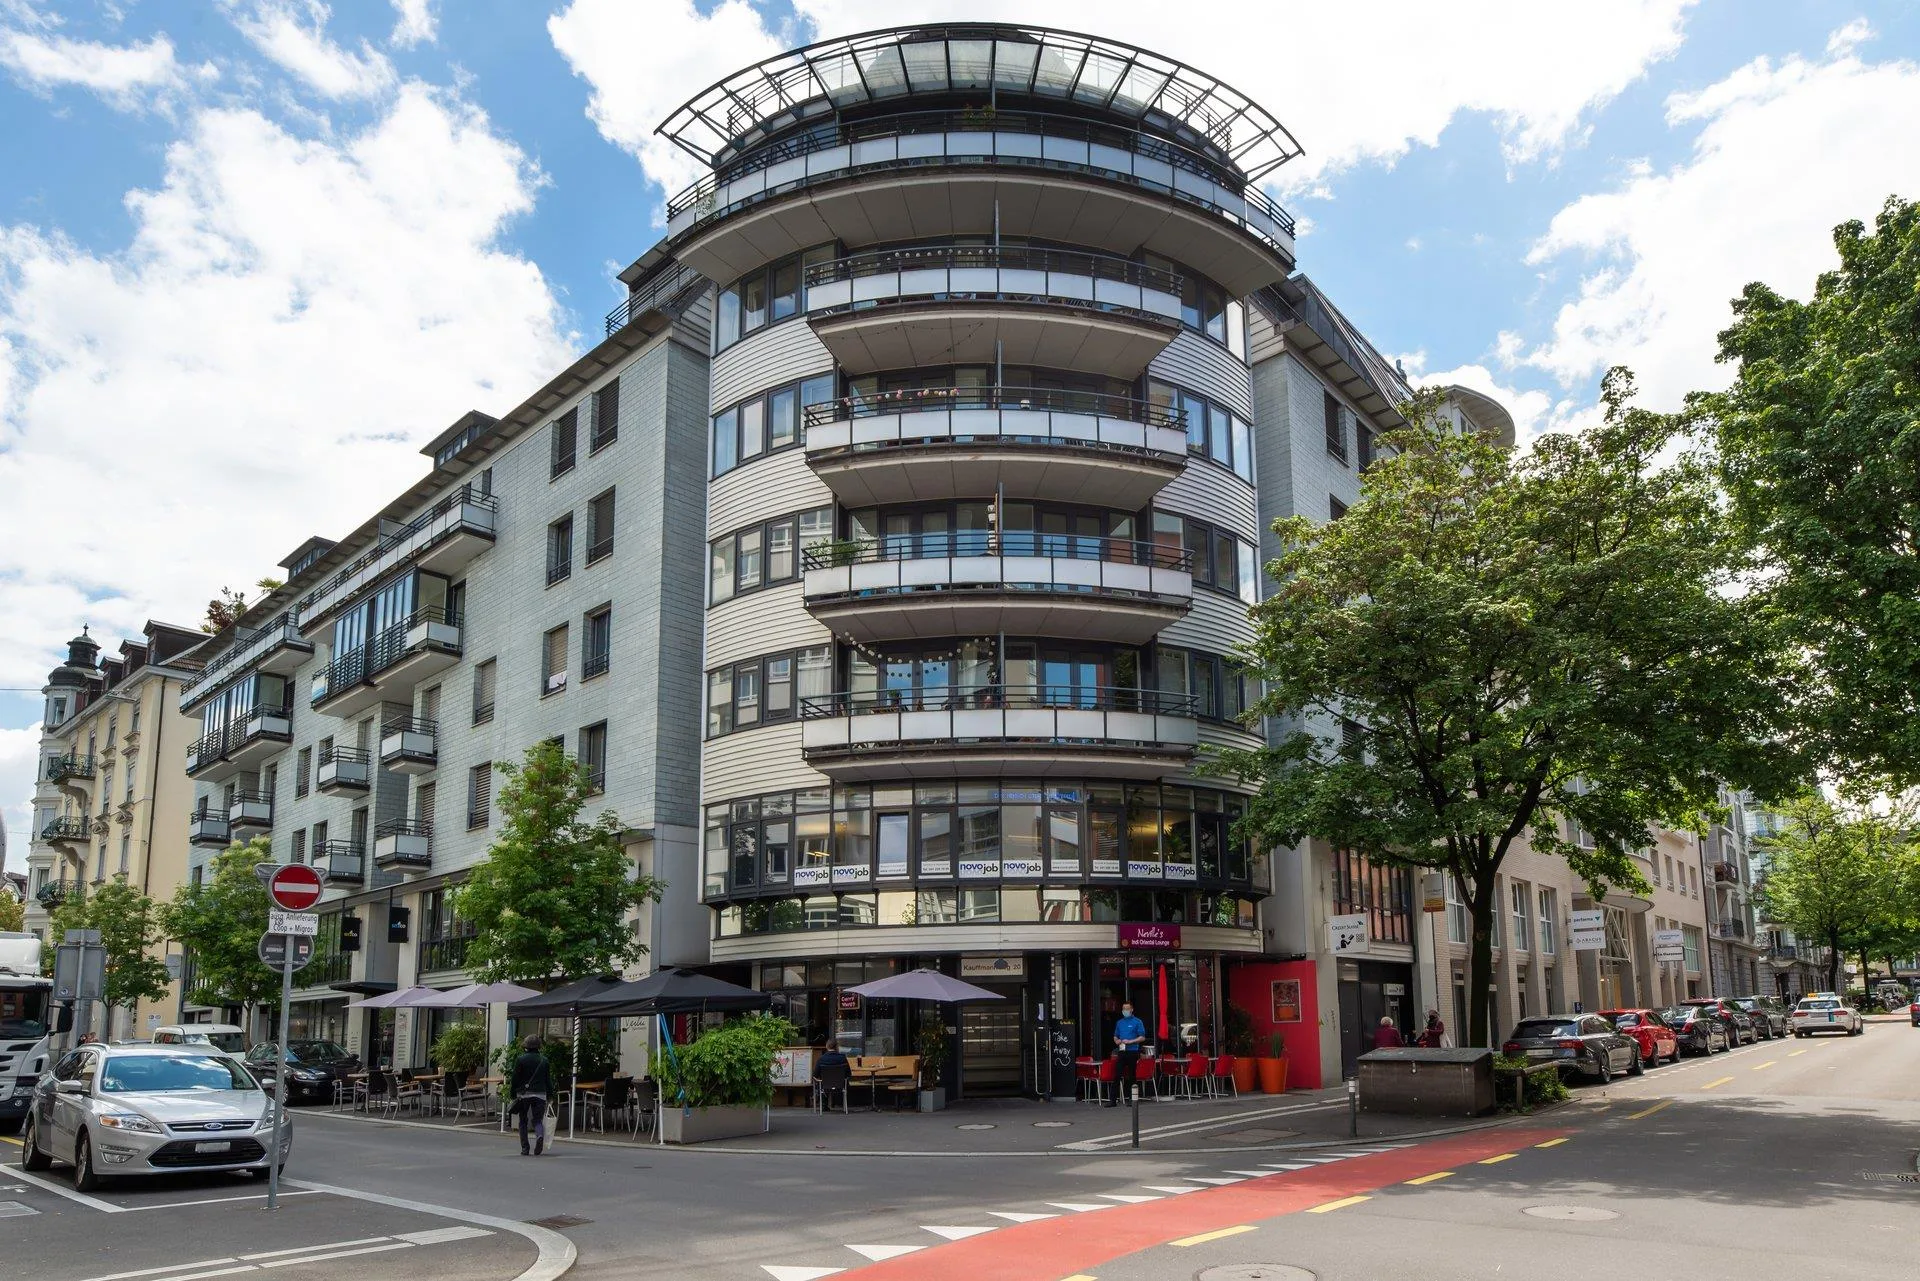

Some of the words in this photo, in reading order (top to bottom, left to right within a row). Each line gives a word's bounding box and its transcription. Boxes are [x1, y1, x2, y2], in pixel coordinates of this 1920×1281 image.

[833, 866, 869, 879] novojob
[960, 863, 998, 874] novojob
[1003, 862, 1042, 874] novojob
[1128, 862, 1161, 875] novojob
[795, 869, 829, 881] novojob
[286, 913, 317, 924] Anlieferung
[273, 925, 288, 933] Coop
[294, 925, 314, 935] Migros
